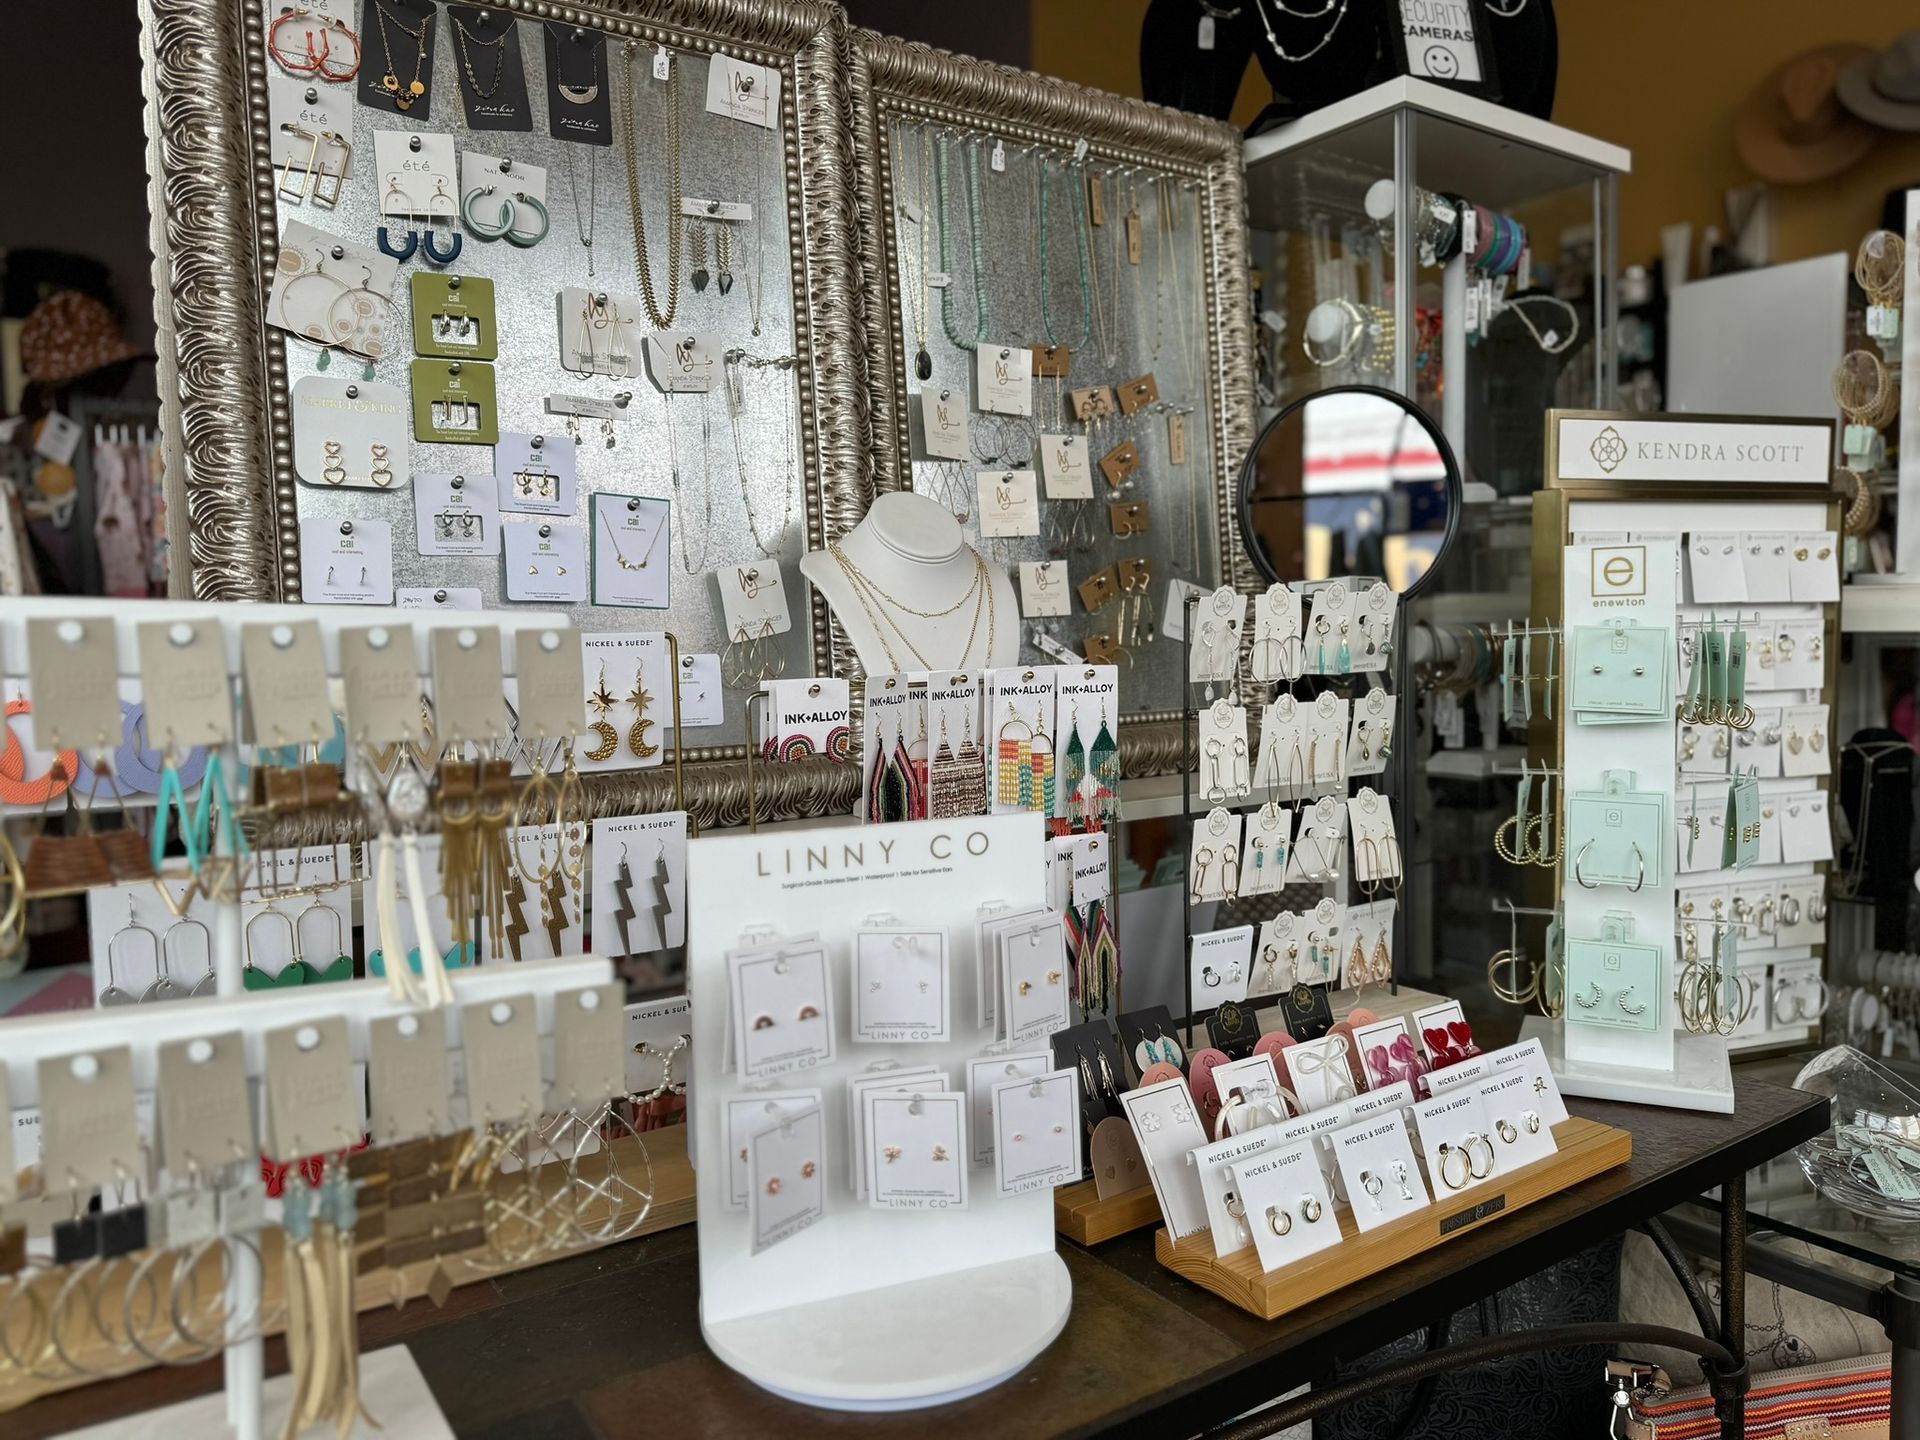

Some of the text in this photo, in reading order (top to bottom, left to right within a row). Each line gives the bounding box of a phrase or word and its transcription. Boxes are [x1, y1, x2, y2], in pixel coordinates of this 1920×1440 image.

[1401, 0, 1471, 27] ECURITY
[299, 109, 328, 125] été
[402, 159, 431, 172] été
[1637, 441, 1805, 463] KENDRA SCOTT
[1592, 597, 1646, 608] enewton
[584, 639, 616, 648] NICKEL
[931, 687, 976, 702] INK+ALLOY
[1000, 683, 1053, 697] INK+ALLOY
[1062, 683, 1114, 695] INK+ALLOY
[869, 693, 907, 708] INK+ALLOY
[783, 709, 848, 726] INK+ALLOY
[608, 823, 637, 834] NICKEL
[639, 823, 645, 831] &
[757, 831, 990, 877] LINNY CO
[1057, 851, 1073, 862] INK
[823, 876, 846, 886] Stainless
[846, 875, 860, 883] Steel
[865, 872, 895, 881] Waterproof
[920, 867, 942, 876] Sensitive
[1075, 860, 1108, 881] INK+ALLOY
[1200, 938, 1222, 949] NICKEL
[631, 1010, 662, 1021] NICKEL
[664, 1008, 669, 1016] &
[872, 1031, 930, 1040] LINNY CO
[1021, 1022, 1059, 1042] LINNY CO
[758, 1056, 817, 1078] LINNY CO
[1495, 1055, 1514, 1066] NICKEL
[1437, 1075, 1458, 1087] NICKEL
[1458, 1073, 1462, 1081] &
[1480, 1085, 1501, 1097] NICKEL
[1354, 1100, 1378, 1114] NICKEL
[1379, 1098, 1383, 1107] &
[1424, 1106, 1446, 1119] NICKEL
[1446, 1104, 1451, 1112] &
[1285, 1126, 1310, 1139] NICKEL
[1310, 1123, 1316, 1132] &
[1344, 1133, 1368, 1147] NICKEL
[1368, 1130, 1374, 1139] &
[1208, 1150, 1235, 1164] NICKEL
[1236, 1147, 1241, 1156] &
[1244, 1164, 1271, 1179] NICKEL
[1272, 1160, 1278, 1170] &
[1013, 1173, 1064, 1194] LINNY CO
[889, 1199, 948, 1209] LINNY CO
